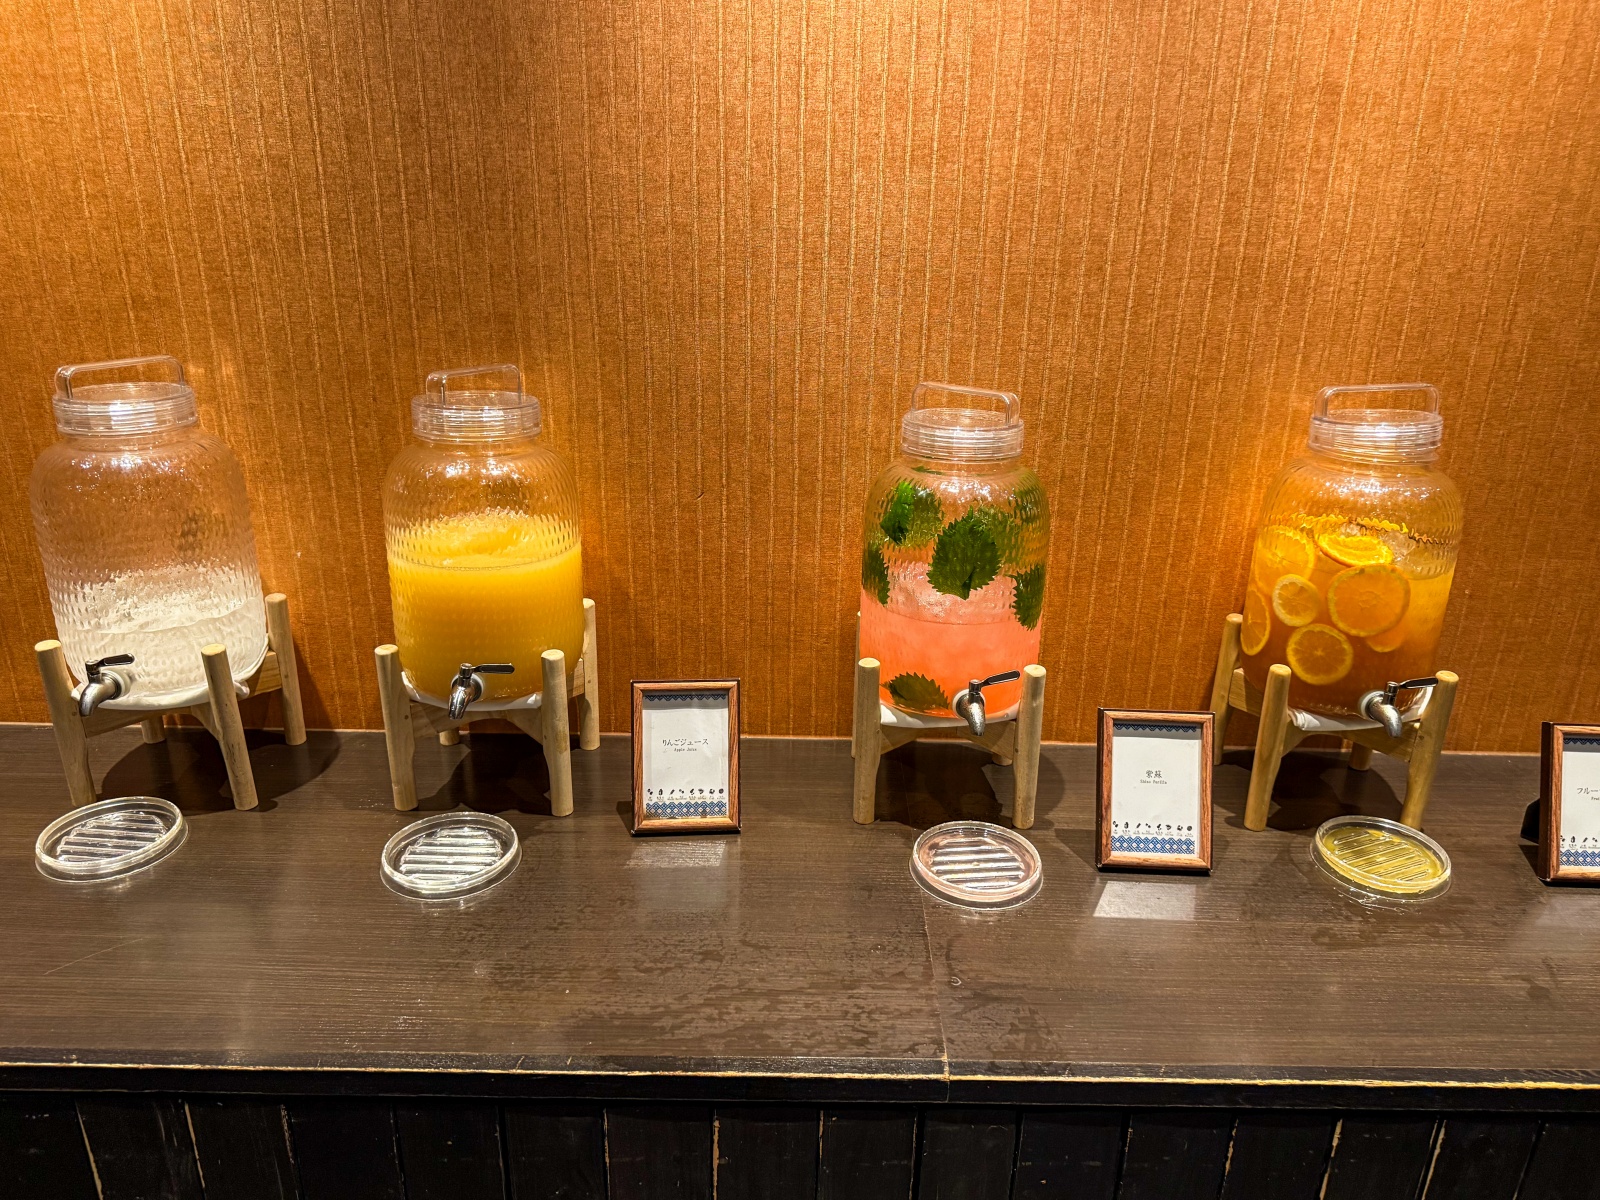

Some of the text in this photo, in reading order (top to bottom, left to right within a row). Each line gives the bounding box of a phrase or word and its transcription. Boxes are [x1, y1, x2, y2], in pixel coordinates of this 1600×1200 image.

[662, 738, 709, 746] りんごジュース
[1577, 787, 1600, 795] フルー
